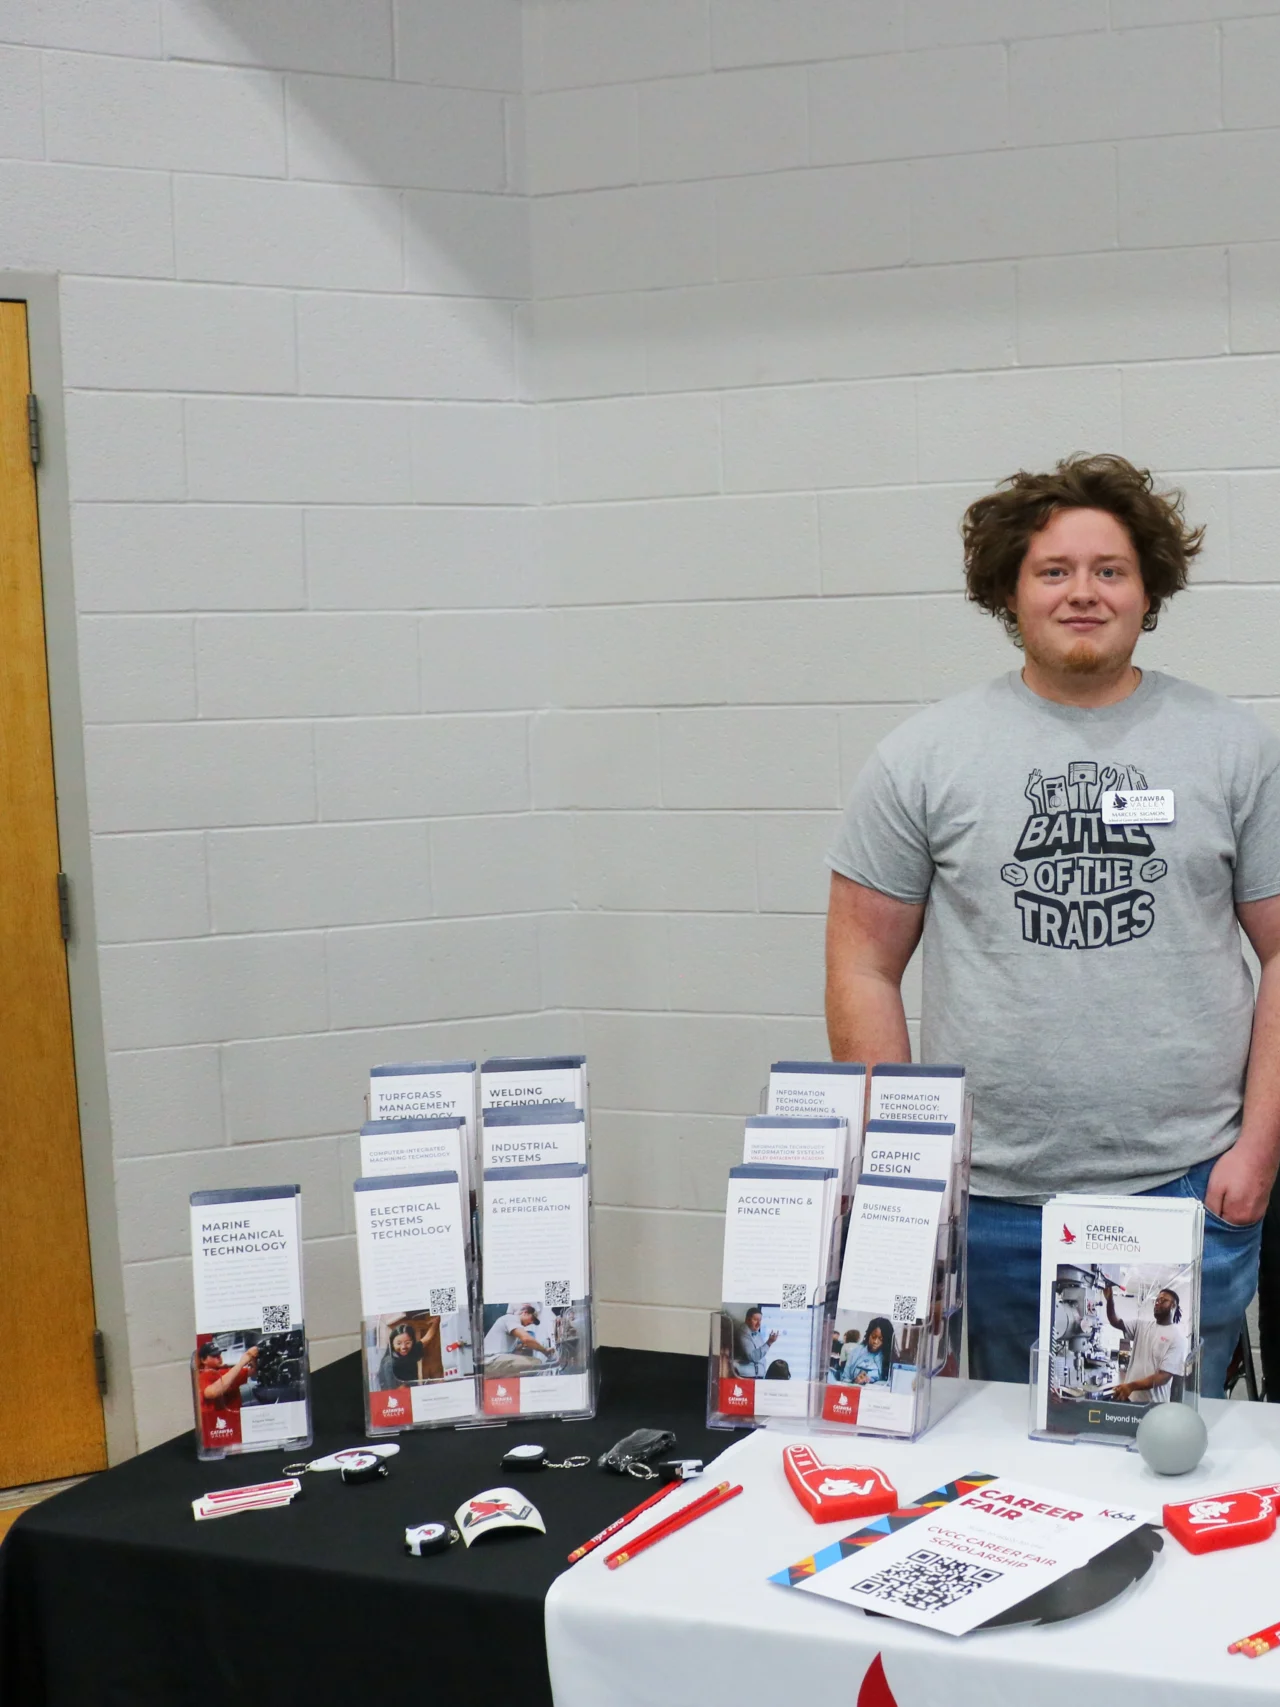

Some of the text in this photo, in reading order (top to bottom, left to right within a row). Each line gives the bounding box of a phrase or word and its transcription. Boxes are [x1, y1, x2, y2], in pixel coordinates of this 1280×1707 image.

[1015, 809, 1154, 860] BATTLE
[1035, 857, 1133, 895] OF THE
[1014, 889, 1156, 949] TRADES
[378, 1090, 442, 1101] TURFGRASS
[489, 1087, 543, 1097] WELDING
[776, 1089, 825, 1097] INFORMATION
[379, 1100, 456, 1112] MANAGEMENT
[489, 1098, 566, 1108] TECHNOLOGY
[880, 1103, 940, 1111] TECHNOLOGY:
[775, 1105, 829, 1113] PROGRAMMING
[880, 1112, 949, 1120] CYBERSECURITY
[491, 1141, 558, 1152] INDUSTRIAL
[369, 1151, 451, 1163] MACHINING TECHNOLOGY
[491, 1153, 542, 1163] SYSTEMS
[871, 1150, 921, 1161] GRAPHIC
[870, 1163, 911, 1173] DESIGN
[491, 1196, 547, 1205] AC, HEATING
[738, 1196, 803, 1205] ACCOUNTING
[370, 1202, 441, 1216] ELECTRICAL
[500, 1204, 571, 1213] REFRIGERATION
[737, 1207, 780, 1216] FINANCE
[862, 1203, 901, 1213] BUSINESS
[371, 1215, 423, 1228] SYSTEMS
[861, 1212, 930, 1226] ADMINISTRATION
[202, 1219, 250, 1232] MARINE
[1086, 1224, 1124, 1234] CAREER
[202, 1229, 284, 1244] MECHANICAL
[371, 1224, 452, 1240] TECHNOLOGY
[1086, 1233, 1139, 1243] TECHNICAL
[203, 1241, 287, 1256] TECHNOLOGY
[1085, 1241, 1141, 1253] EDUCATION
[1105, 1413, 1130, 1423] beyond
[959, 1498, 1023, 1521] FAIR
[979, 1489, 1084, 1521] CAREER
[1098, 1508, 1137, 1522] K64
[927, 1525, 965, 1540] CVCC
[966, 1536, 1023, 1558] CAREER
[1023, 1552, 1057, 1567] FAIR
[929, 1536, 1028, 1569] SCHOLARSHIP
